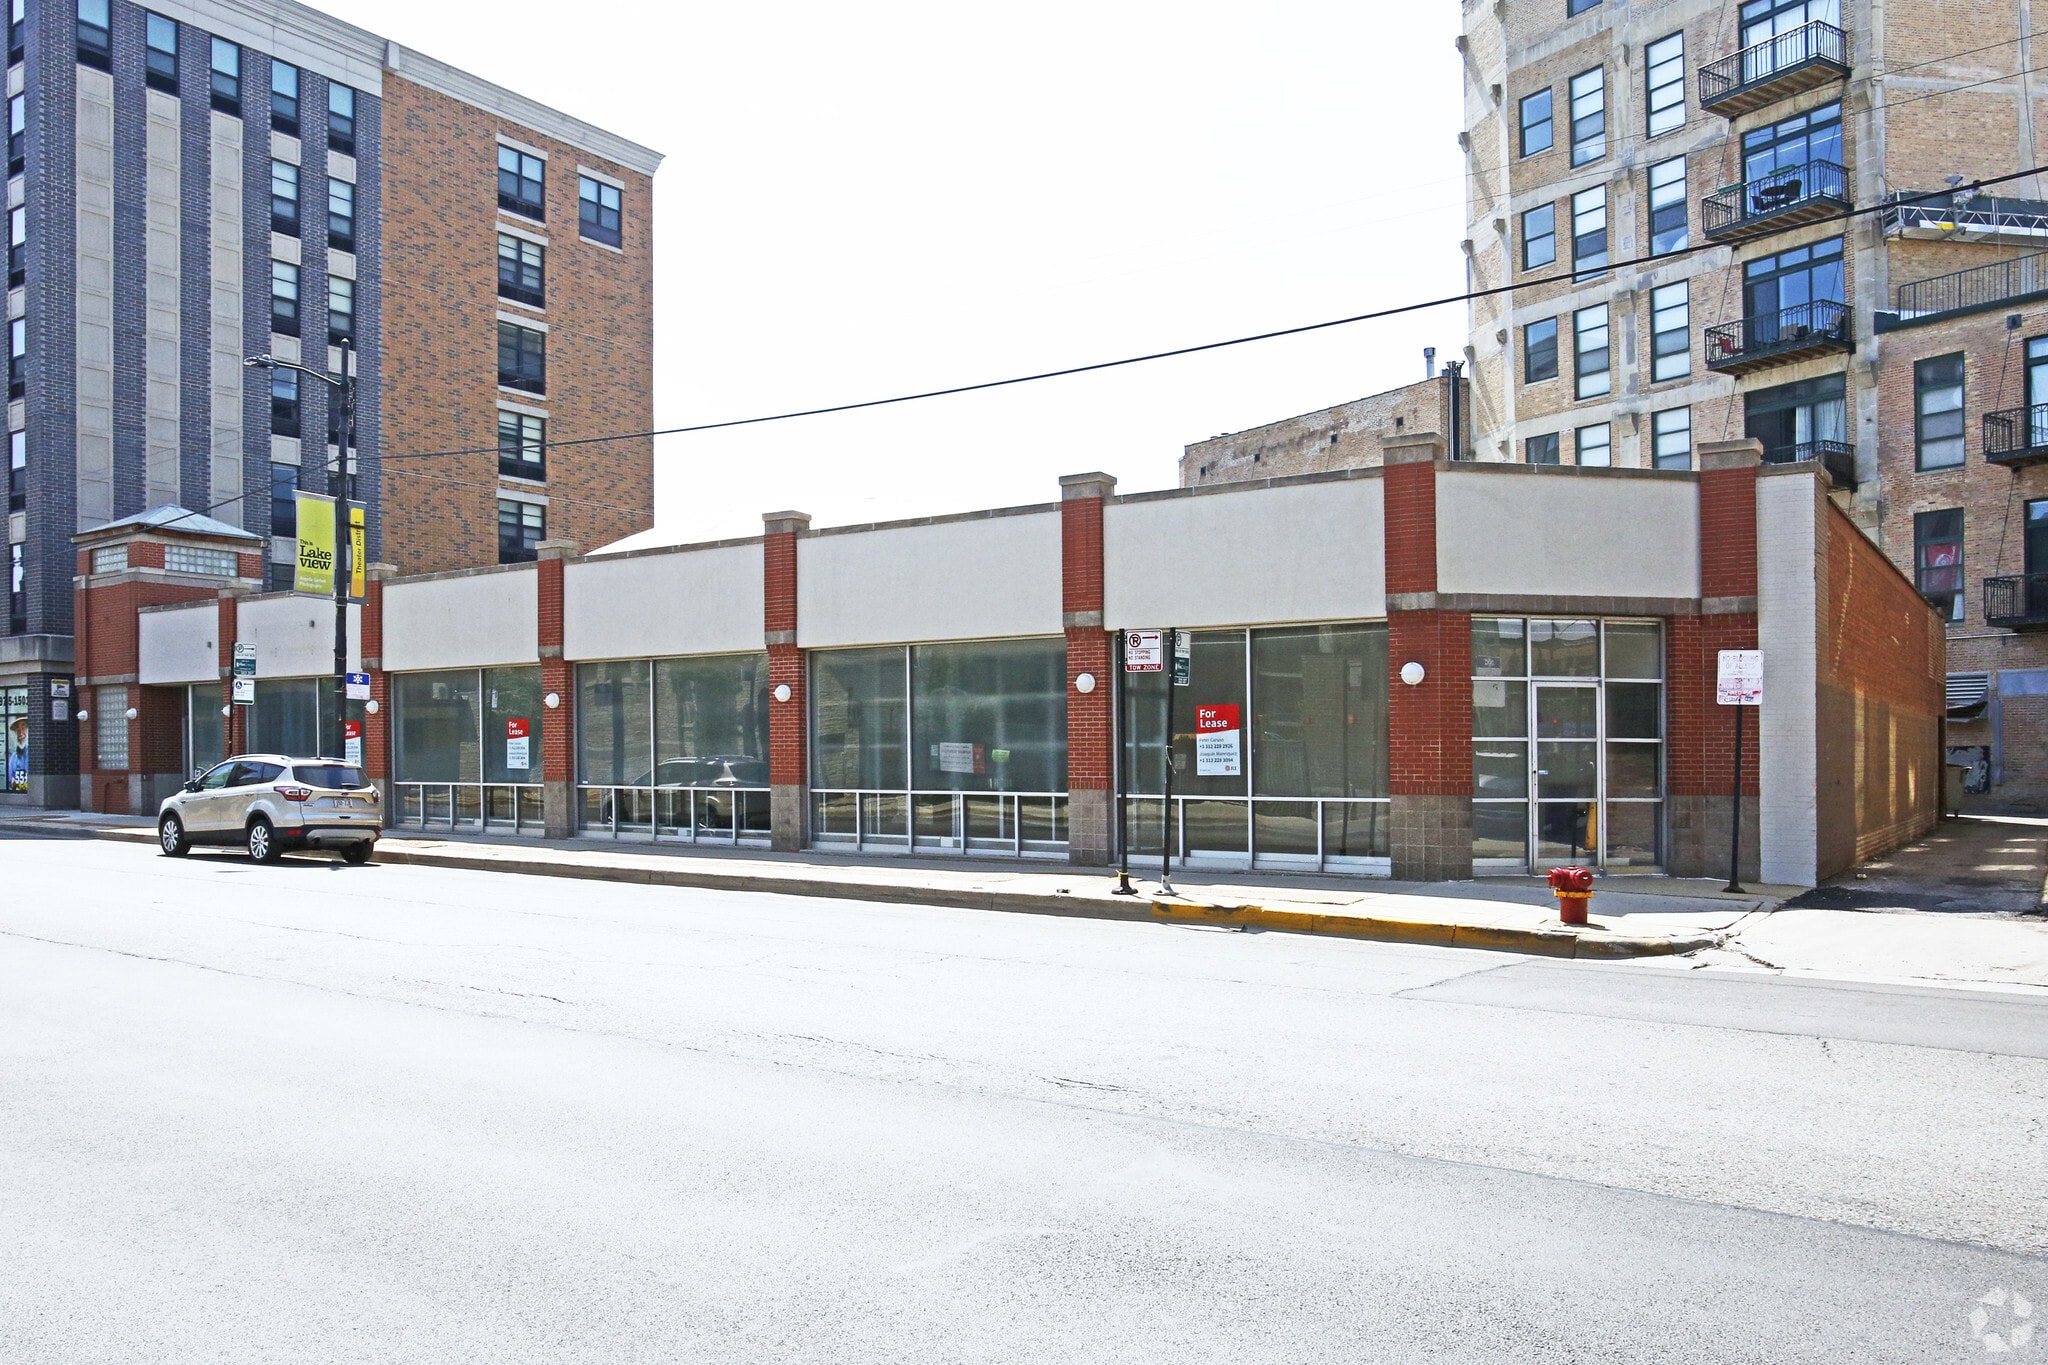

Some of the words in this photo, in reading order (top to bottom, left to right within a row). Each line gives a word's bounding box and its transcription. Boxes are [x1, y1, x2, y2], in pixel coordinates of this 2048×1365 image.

[300, 545, 332, 560] Lake
[299, 558, 331, 570] view
[1200, 709, 1216, 718] For
[1200, 719, 1228, 728] Lease
